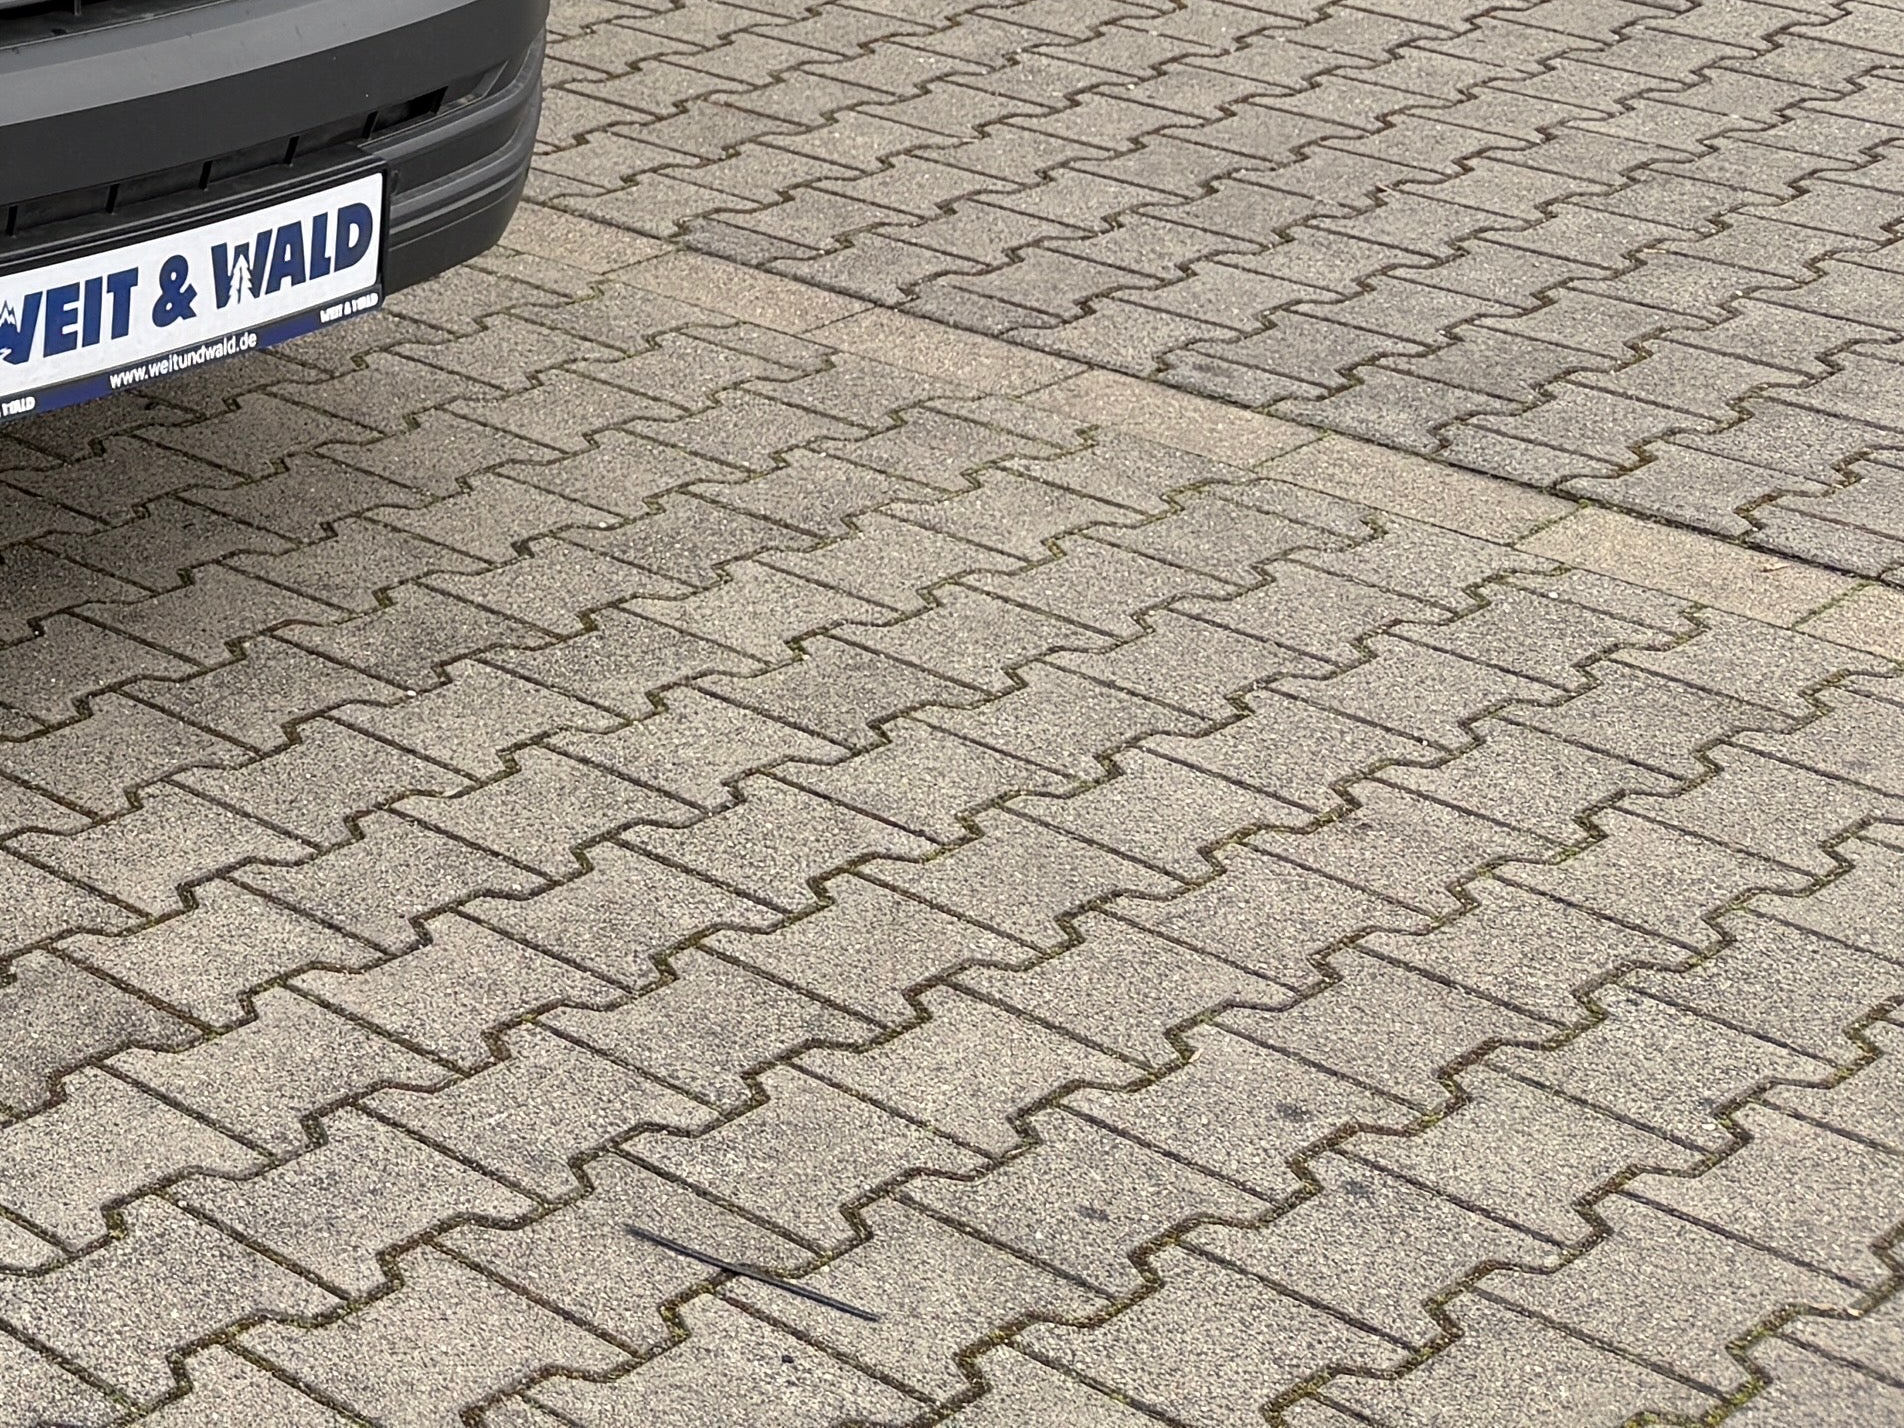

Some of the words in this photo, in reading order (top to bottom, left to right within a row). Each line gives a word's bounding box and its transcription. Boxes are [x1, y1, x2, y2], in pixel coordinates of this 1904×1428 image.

[152, 254, 197, 328] &
[210, 202, 374, 310] WALD
[109, 331, 258, 390] www.weitundwald.de
